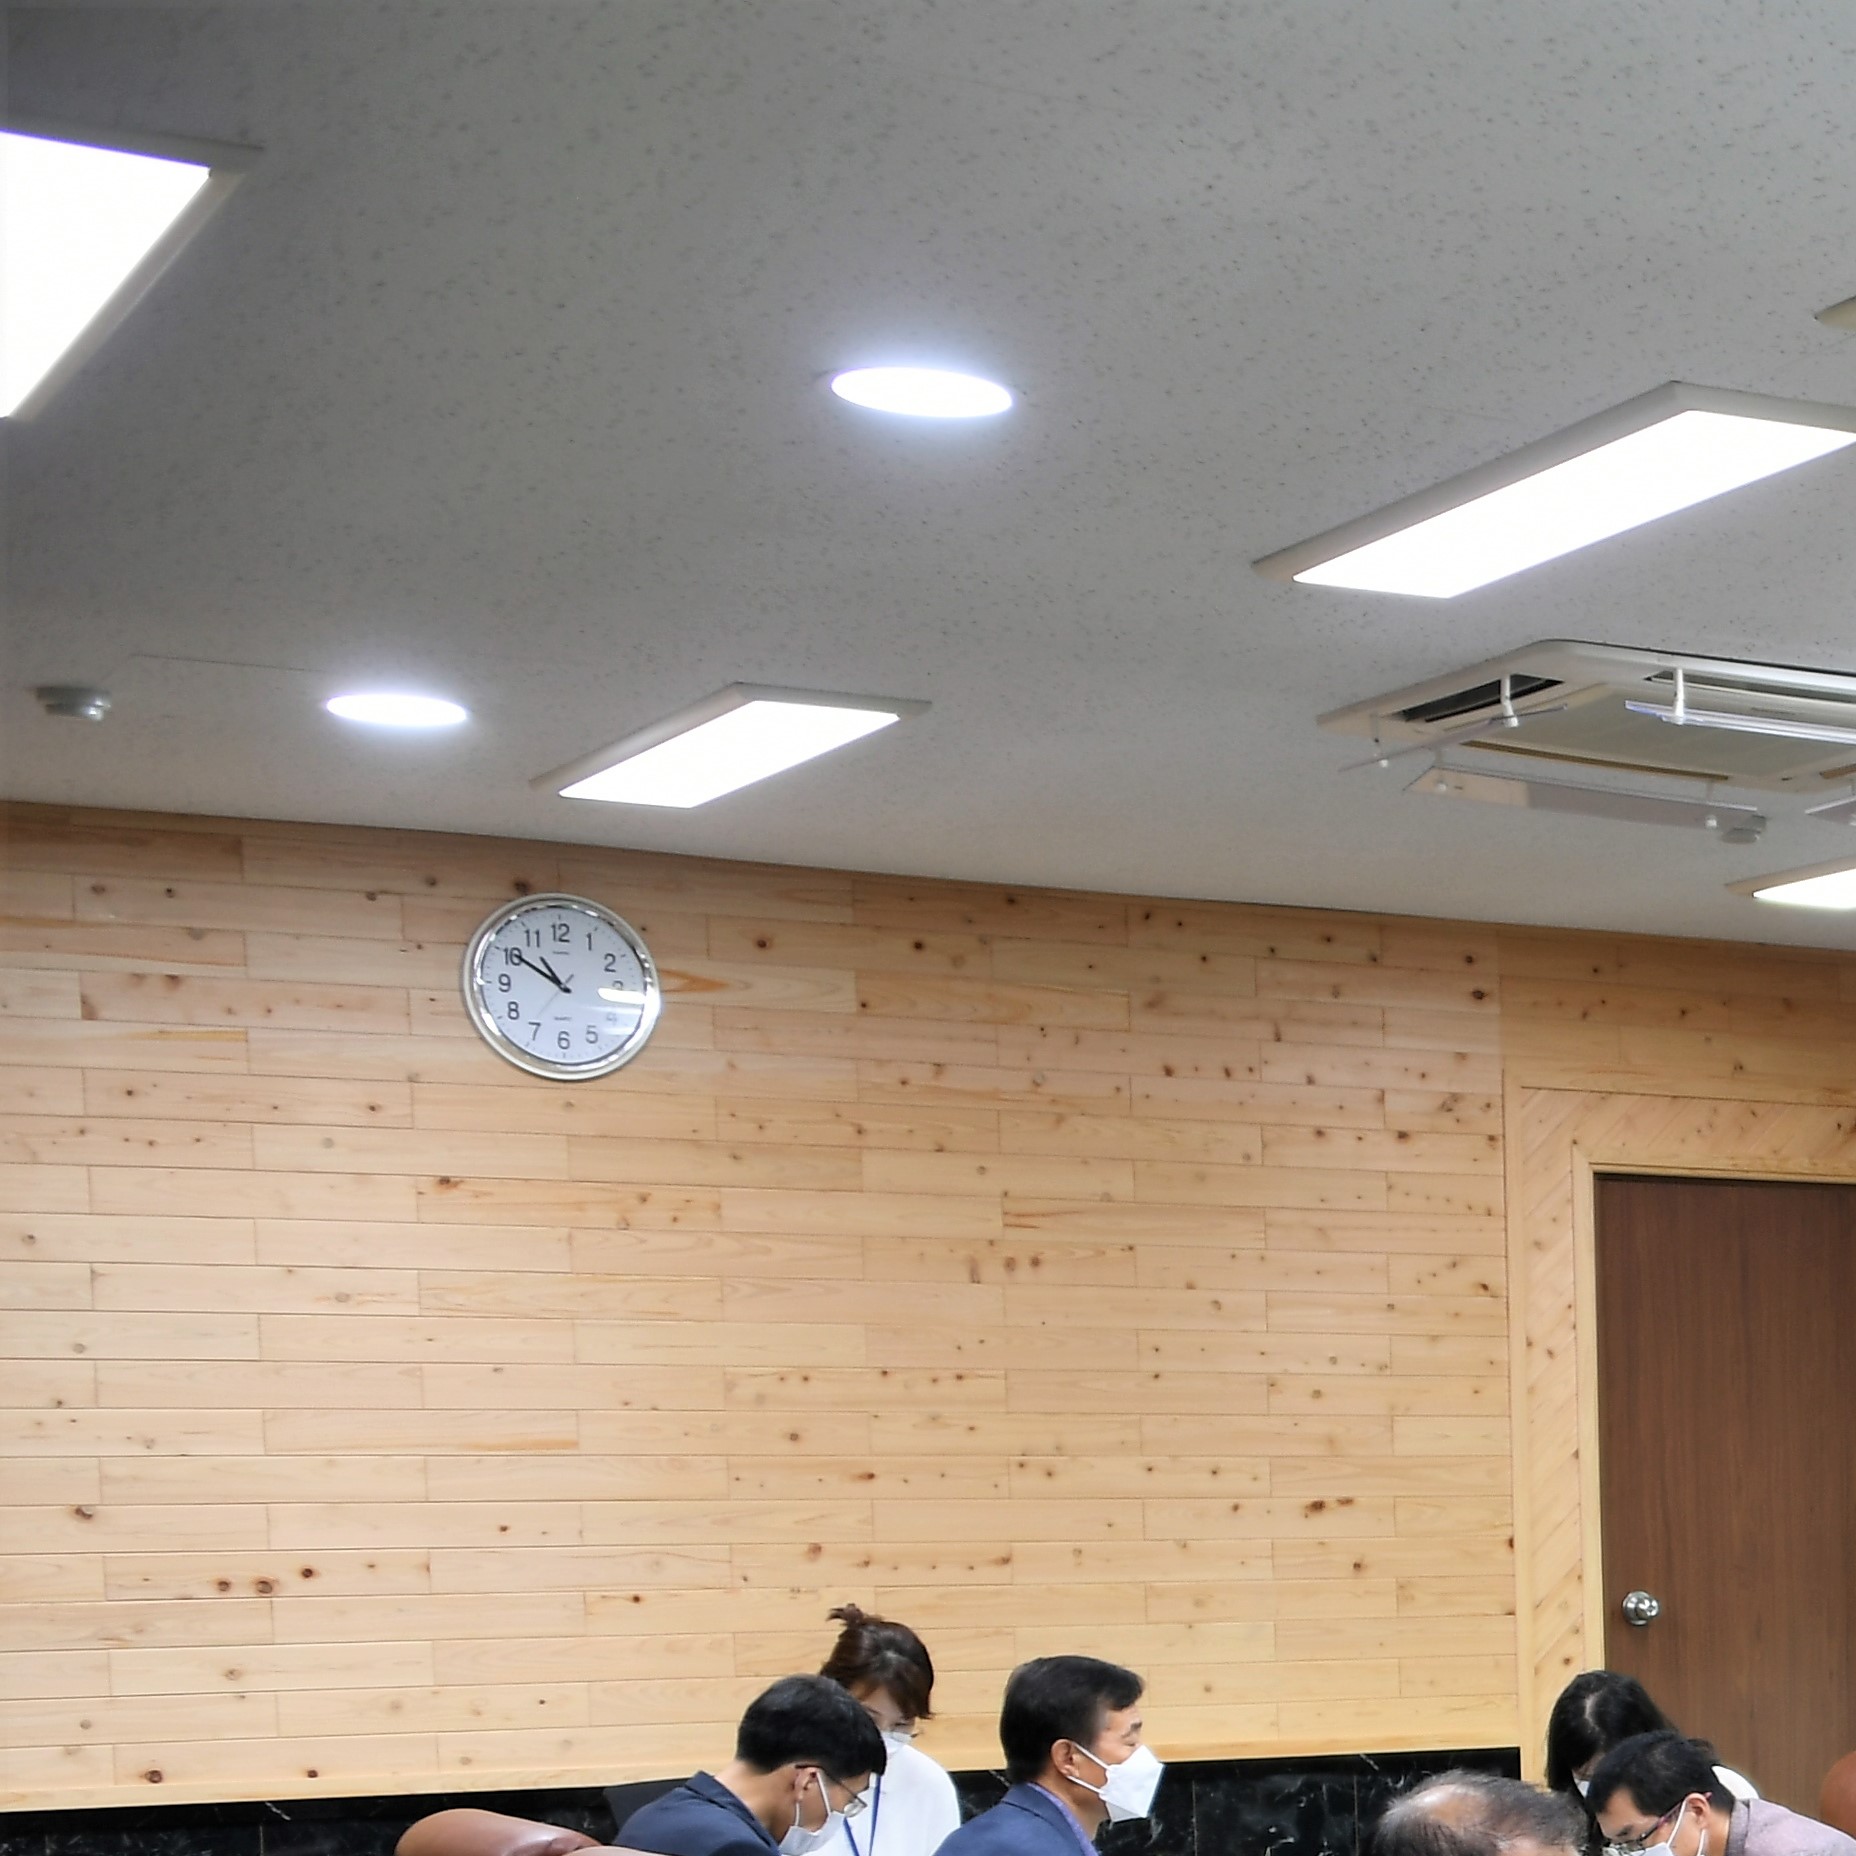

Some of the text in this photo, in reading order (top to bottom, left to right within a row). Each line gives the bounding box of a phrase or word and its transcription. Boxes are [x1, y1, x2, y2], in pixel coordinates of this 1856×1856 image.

[524, 928, 541, 948] 11
[551, 923, 570, 943] 12
[586, 932, 592, 951] 1
[503, 947, 522, 967] 10
[603, 953, 617, 973] 2
[498, 973, 511, 993] 9
[507, 1001, 520, 1020] 8
[528, 1021, 542, 1041] 7
[557, 1030, 570, 1050] 6
[586, 1025, 599, 1044] 5
